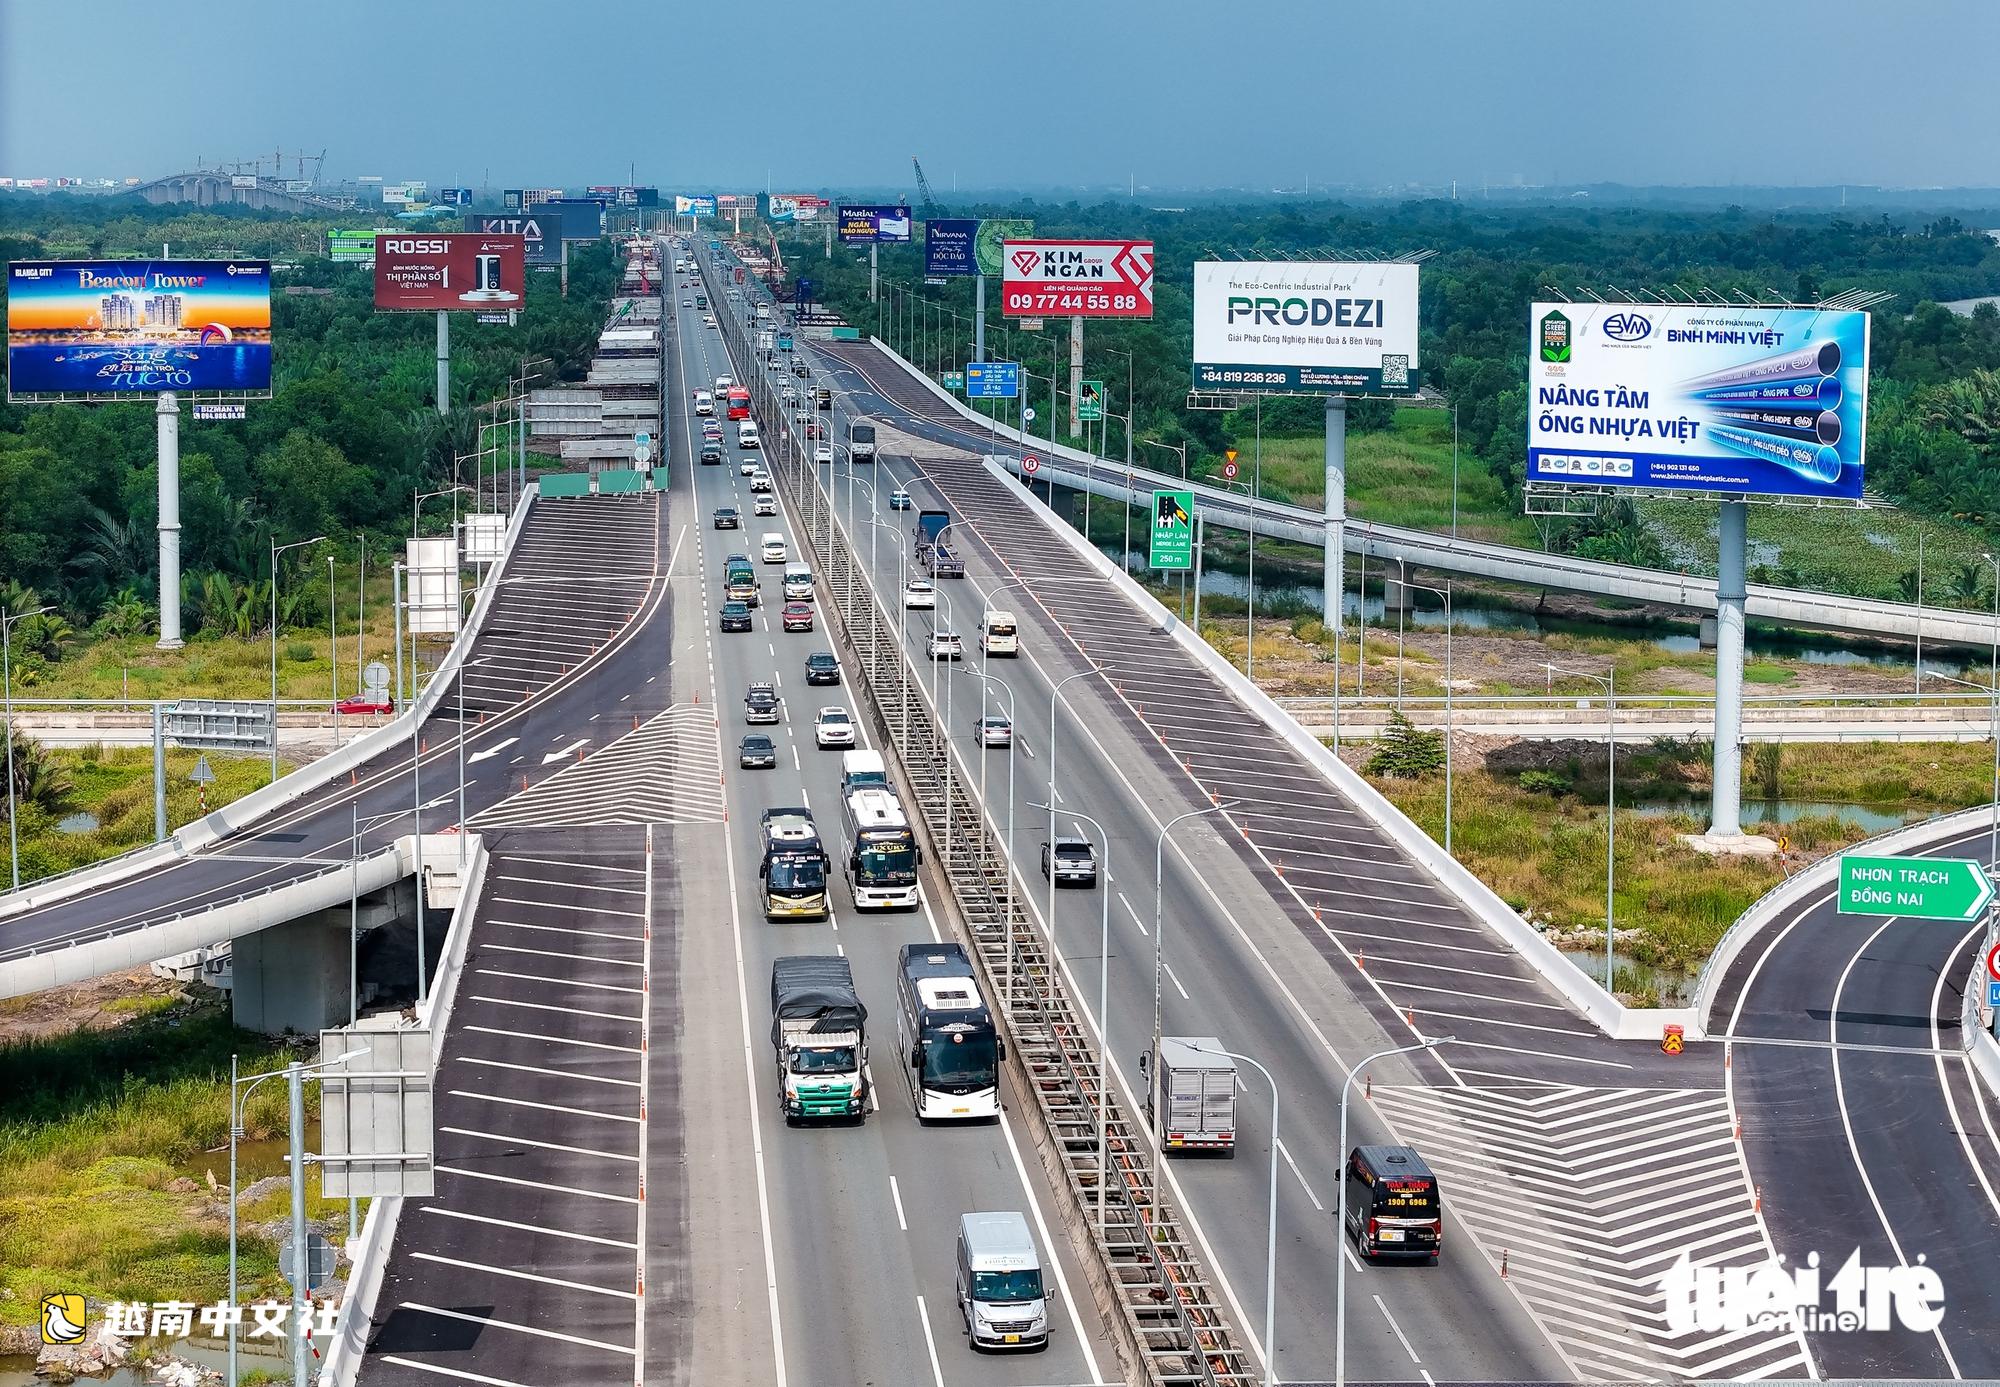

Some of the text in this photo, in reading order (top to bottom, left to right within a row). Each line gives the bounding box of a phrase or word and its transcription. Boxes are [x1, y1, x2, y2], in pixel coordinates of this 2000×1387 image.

[386, 240, 448, 253] ROSSI
[1045, 252, 1082, 263] KIM
[39, 268, 52, 276] CITY
[386, 265, 448, 288] THỊ PHẦN SỐ 1
[1045, 265, 1103, 277] NGAN
[79, 270, 207, 288] Beacon Tower
[1245, 282, 1292, 290] Eco-Centric
[1010, 294, 1136, 310] 09 77 44 55 88
[1228, 297, 1383, 327] PRODEZI
[1745, 320, 1764, 328] NHỰA
[1263, 334, 1280, 344] Công
[1282, 335, 1306, 345] Nghiệp
[1308, 336, 1324, 345] Hiệu
[1342, 337, 1346, 345] &
[1748, 328, 1784, 348] VIỆT
[1768, 363, 1786, 374] PVC-U
[1202, 372, 1286, 383] +84 819 236 236
[1540, 384, 1649, 409] NÂNG TẦM
[1776, 416, 1791, 424] HDPE
[1539, 409, 1700, 444] ỐNG NHỰA VIỆT
[1651, 463, 1666, 471] (+84)
[1650, 472, 1749, 484] www.binhminhvietplastic.com.vn
[1155, 531, 1188, 539] NHẬP LÀN
[1160, 555, 1173, 563] 250
[1852, 868, 1948, 886] NHƠN TRẠCH
[1851, 886, 1923, 906] ĐỒNG NAI
